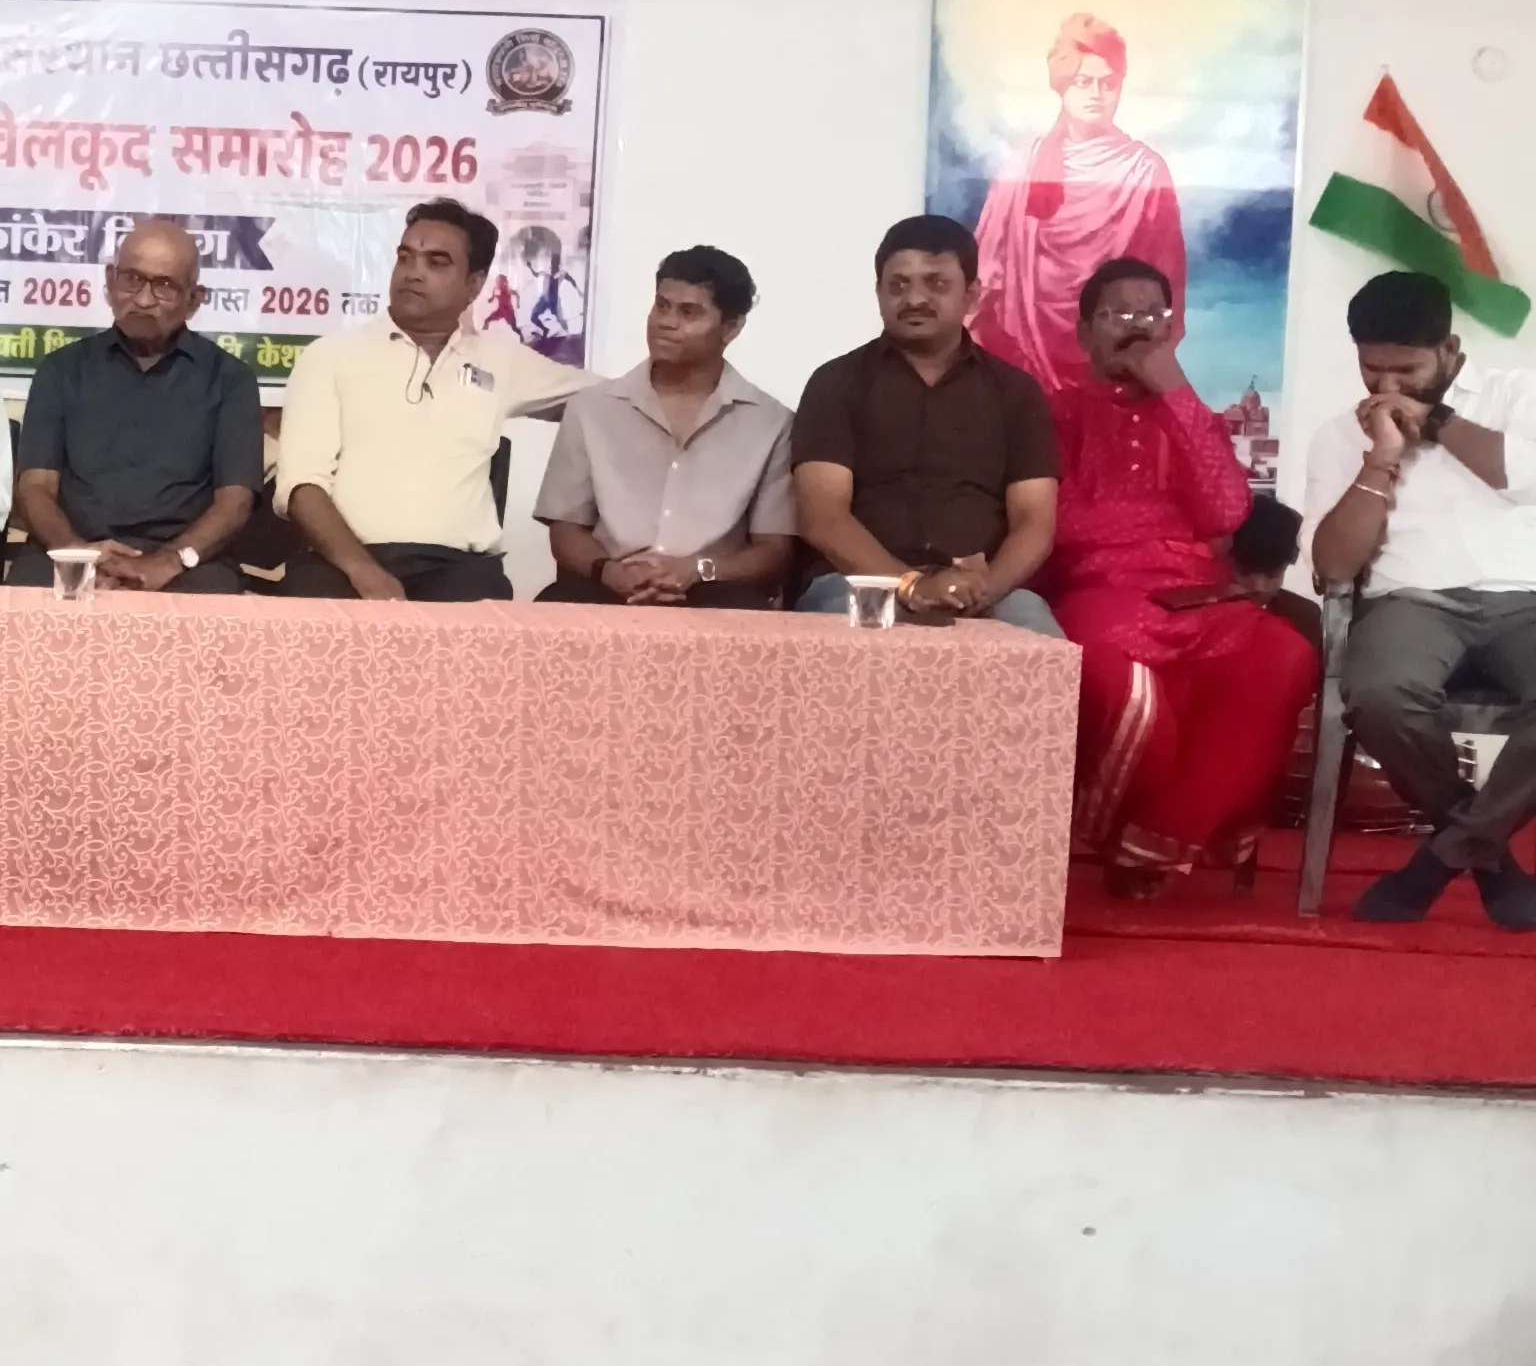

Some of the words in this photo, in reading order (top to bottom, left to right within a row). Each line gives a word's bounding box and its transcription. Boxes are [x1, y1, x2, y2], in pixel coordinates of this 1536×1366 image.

[161, 29, 352, 97] छत्तीसगढ़
[358, 56, 472, 99] (रायपुर)
[170, 110, 352, 186] समारोह
[364, 136, 478, 184] 2026
[23, 277, 92, 307] 2026
[201, 287, 251, 313] गस्त
[261, 286, 330, 316] 2026
[342, 292, 380, 315] तक
